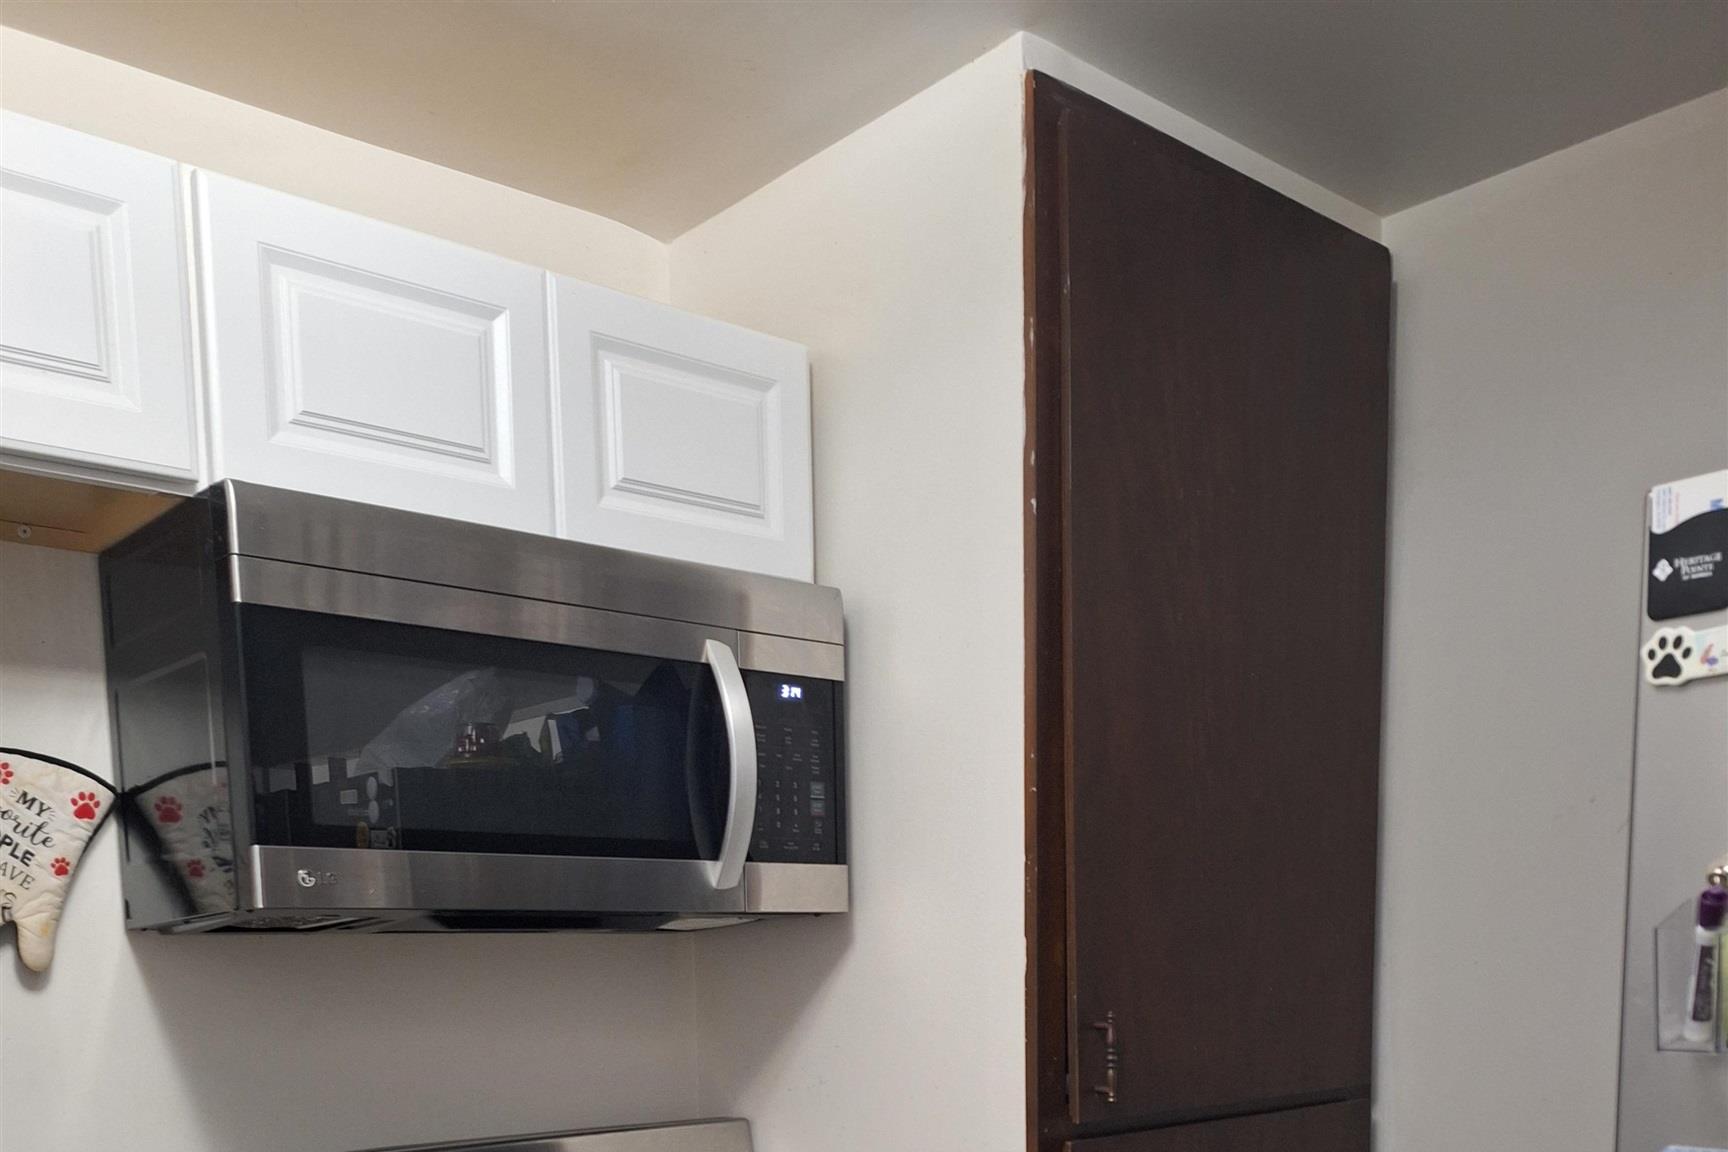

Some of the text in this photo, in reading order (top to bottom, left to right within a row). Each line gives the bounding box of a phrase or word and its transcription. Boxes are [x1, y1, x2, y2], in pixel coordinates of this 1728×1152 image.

[16, 790, 53, 818] MY
[0, 806, 56, 848] orite
[0, 833, 36, 868] PLE
[0, 861, 36, 890] AVE
